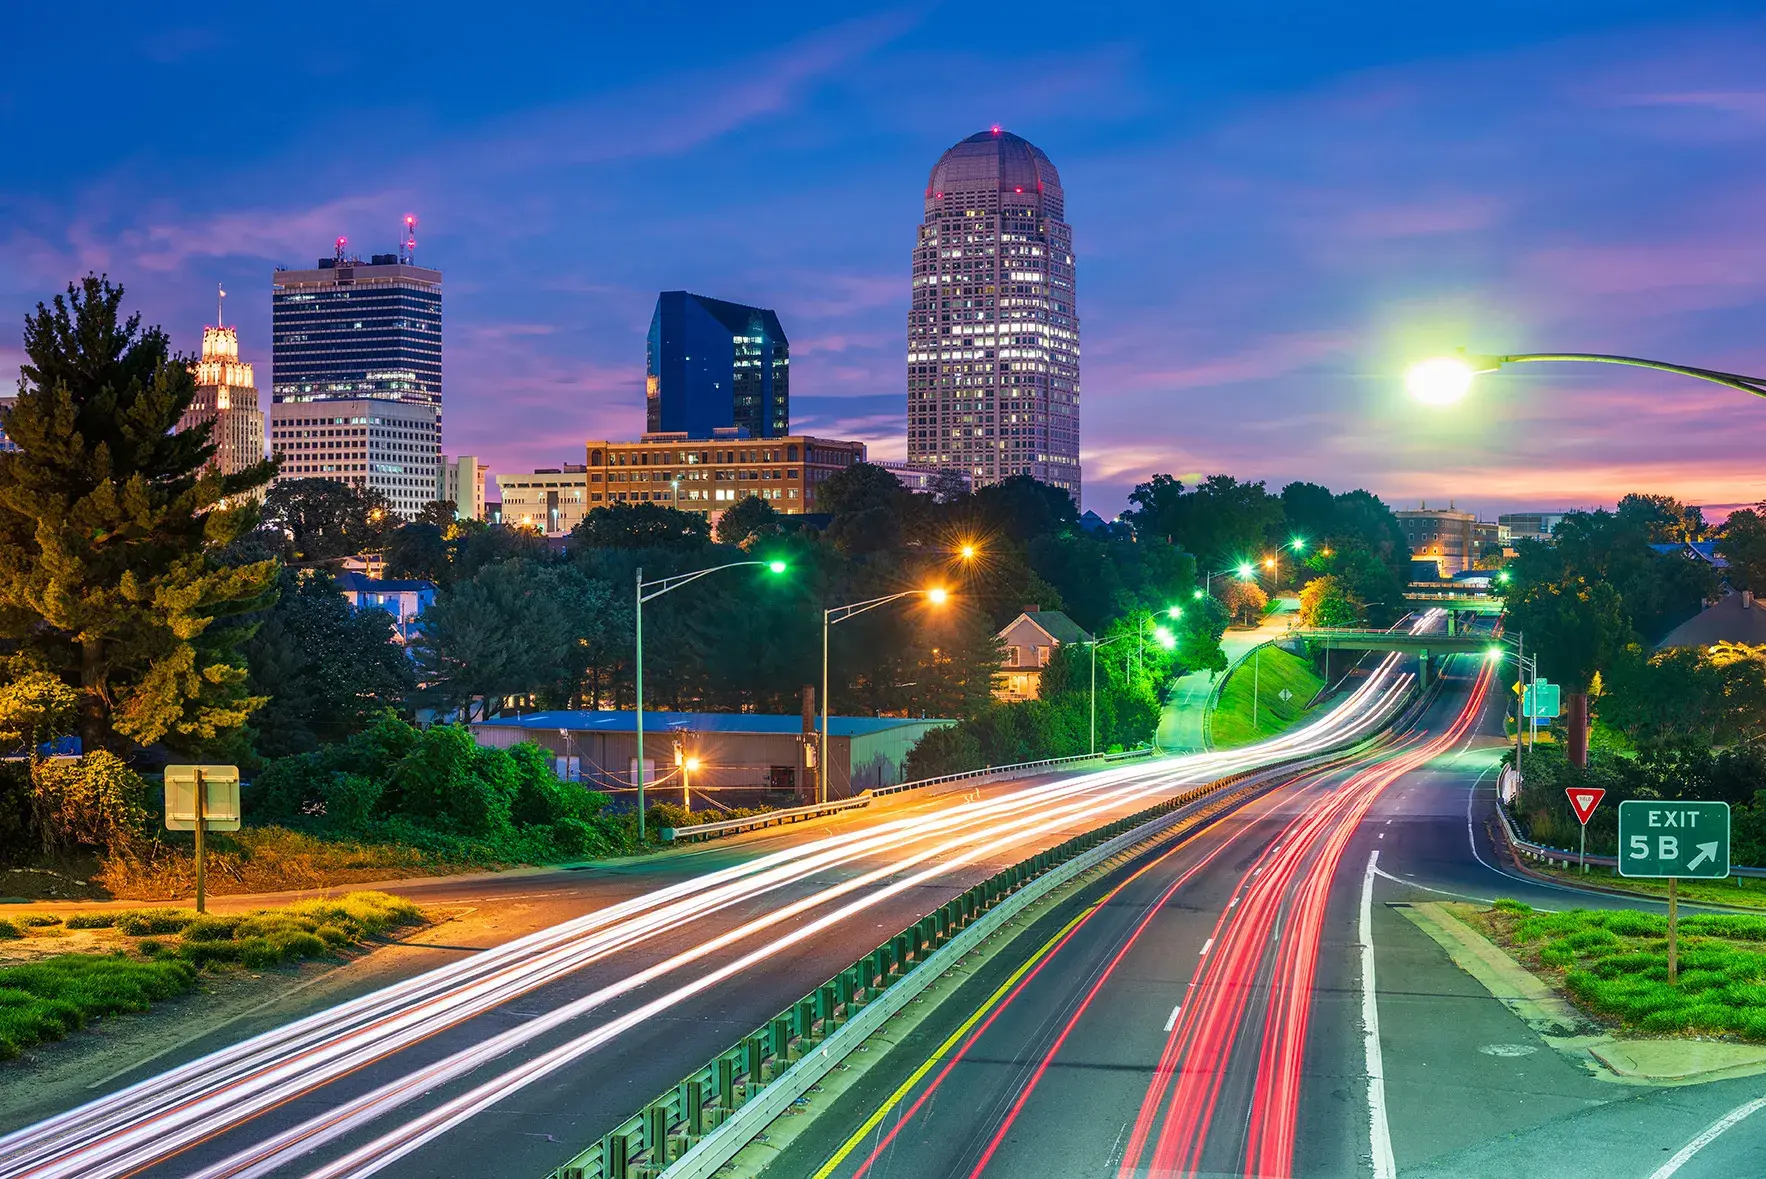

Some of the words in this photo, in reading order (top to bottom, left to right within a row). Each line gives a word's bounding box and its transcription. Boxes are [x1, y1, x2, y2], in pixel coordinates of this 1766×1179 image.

[1648, 811, 1700, 828] EXIT
[1629, 835, 1650, 859] 5
[1658, 835, 1679, 860] B
